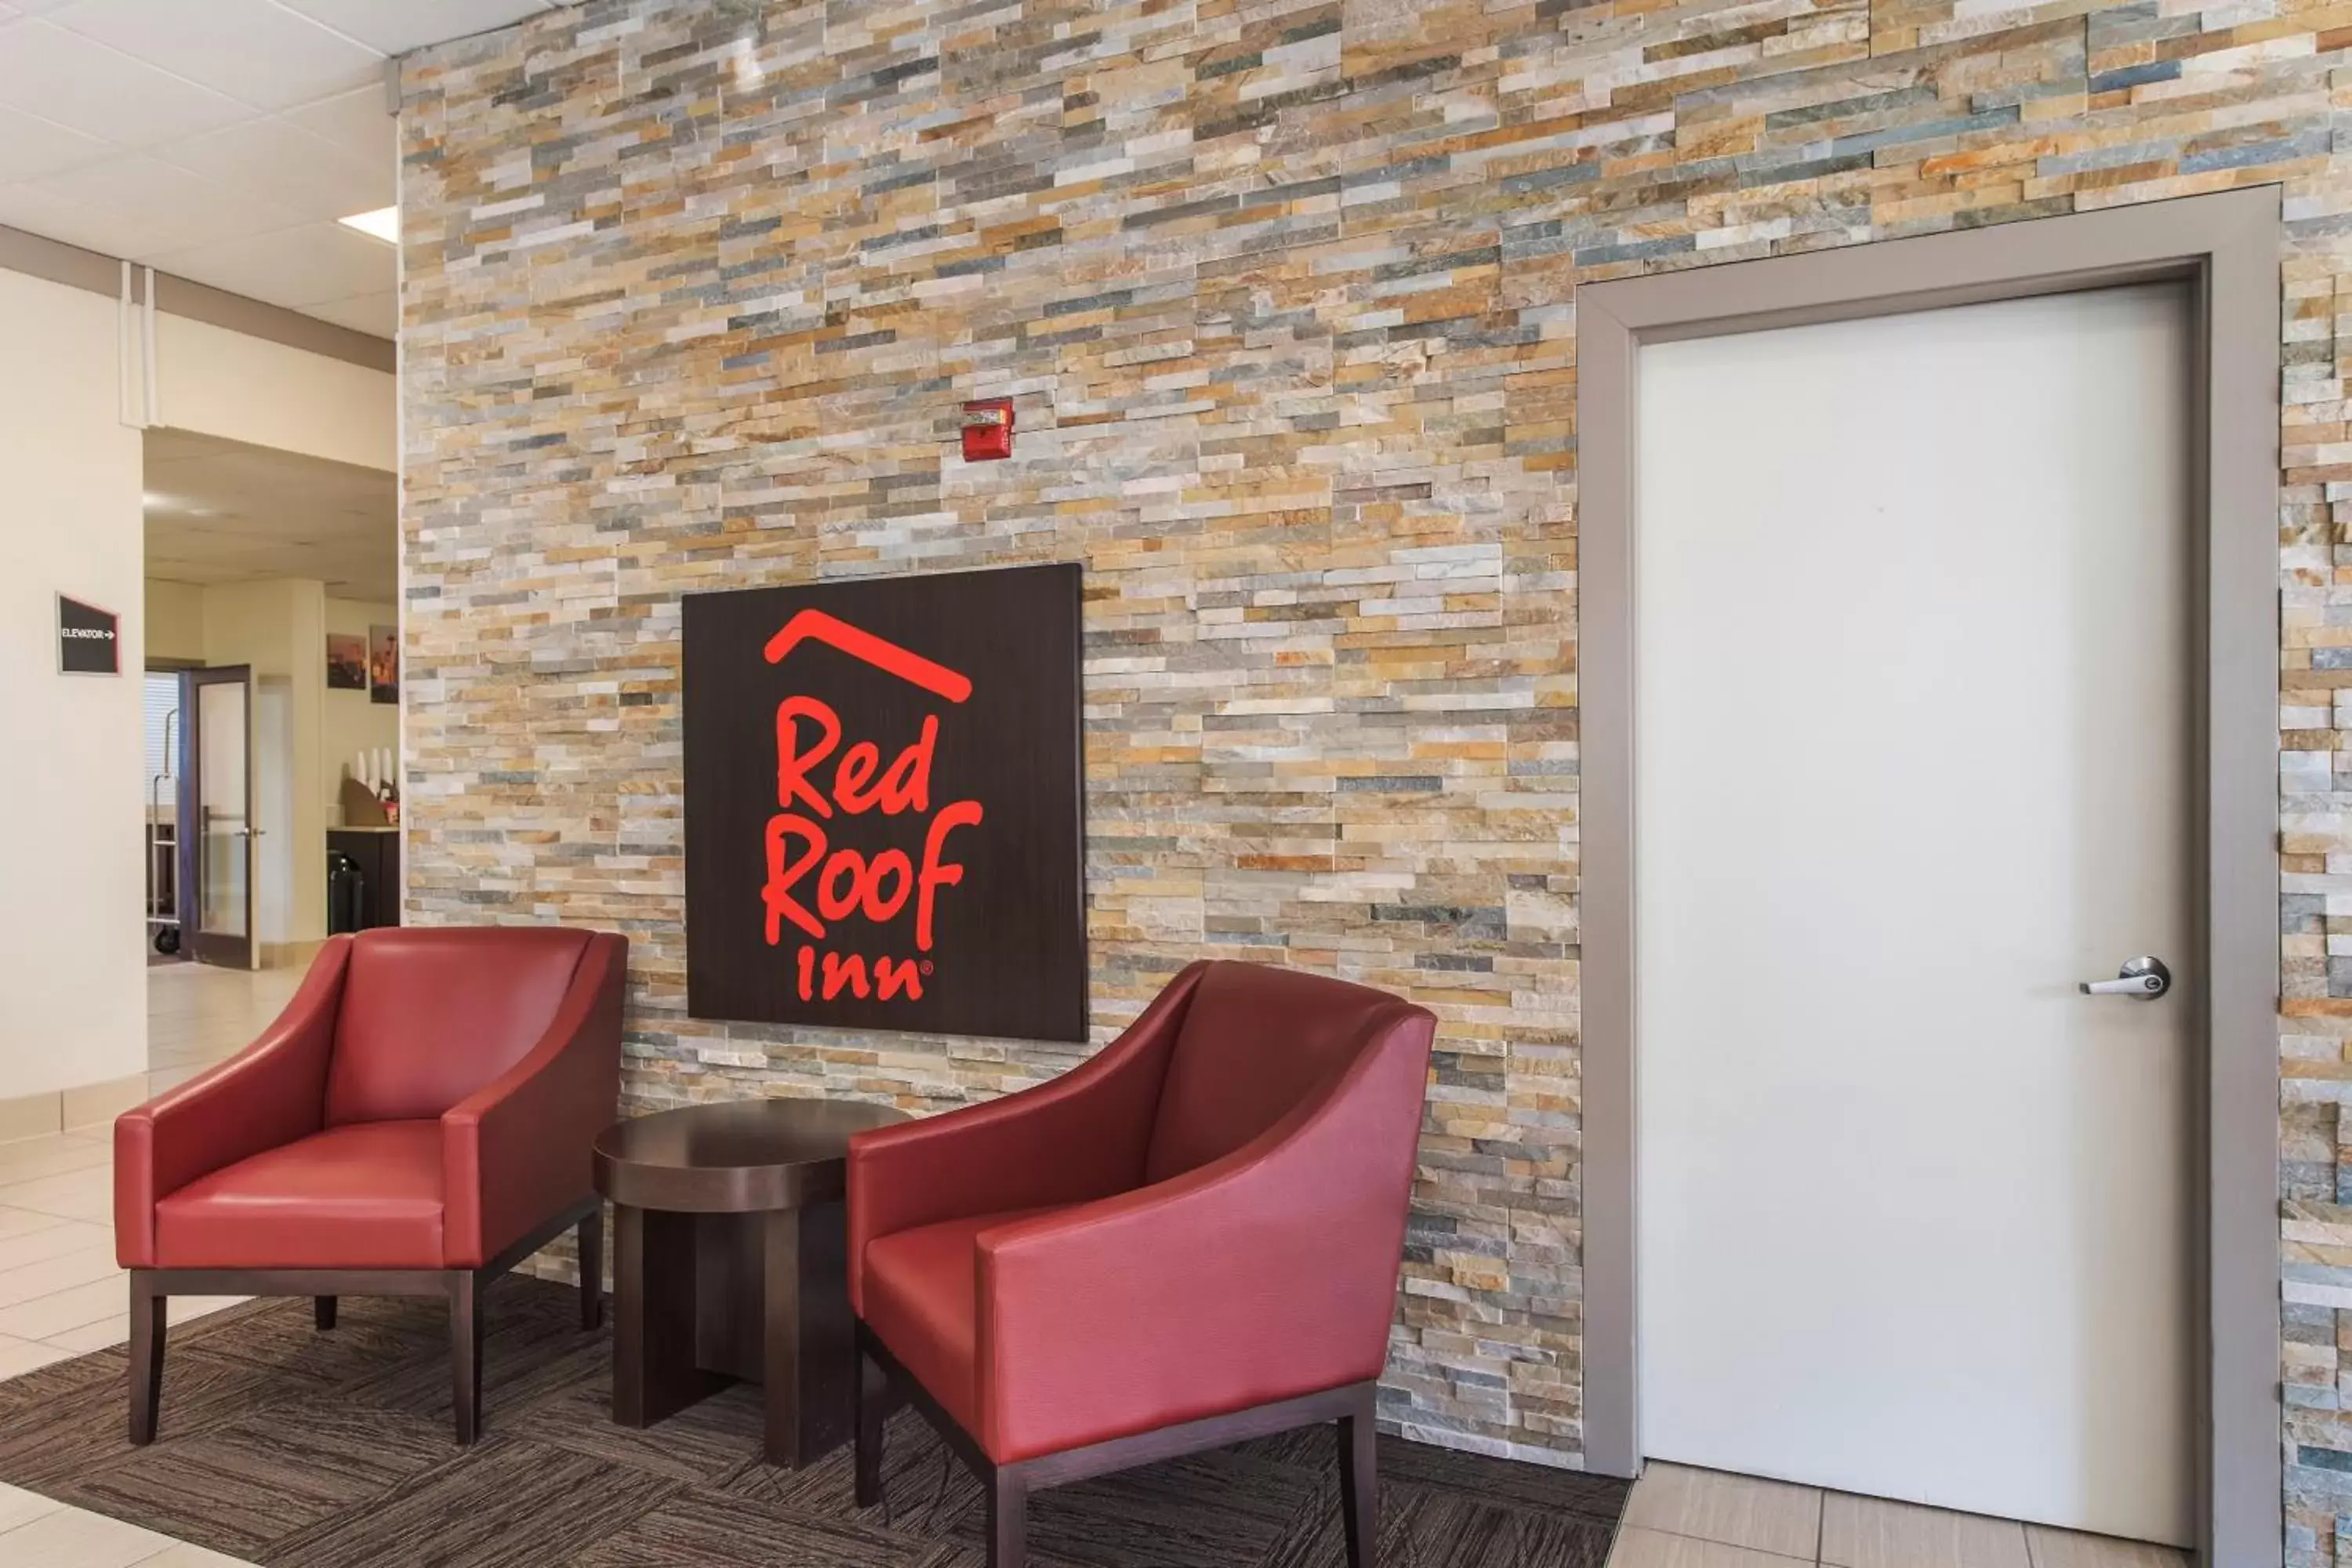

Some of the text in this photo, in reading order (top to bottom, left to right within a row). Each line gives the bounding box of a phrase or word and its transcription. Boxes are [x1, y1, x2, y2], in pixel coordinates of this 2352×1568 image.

[62, 627, 103, 639] ELEVATOR
[776, 695, 938, 818] Red
[761, 800, 983, 951] Roof
